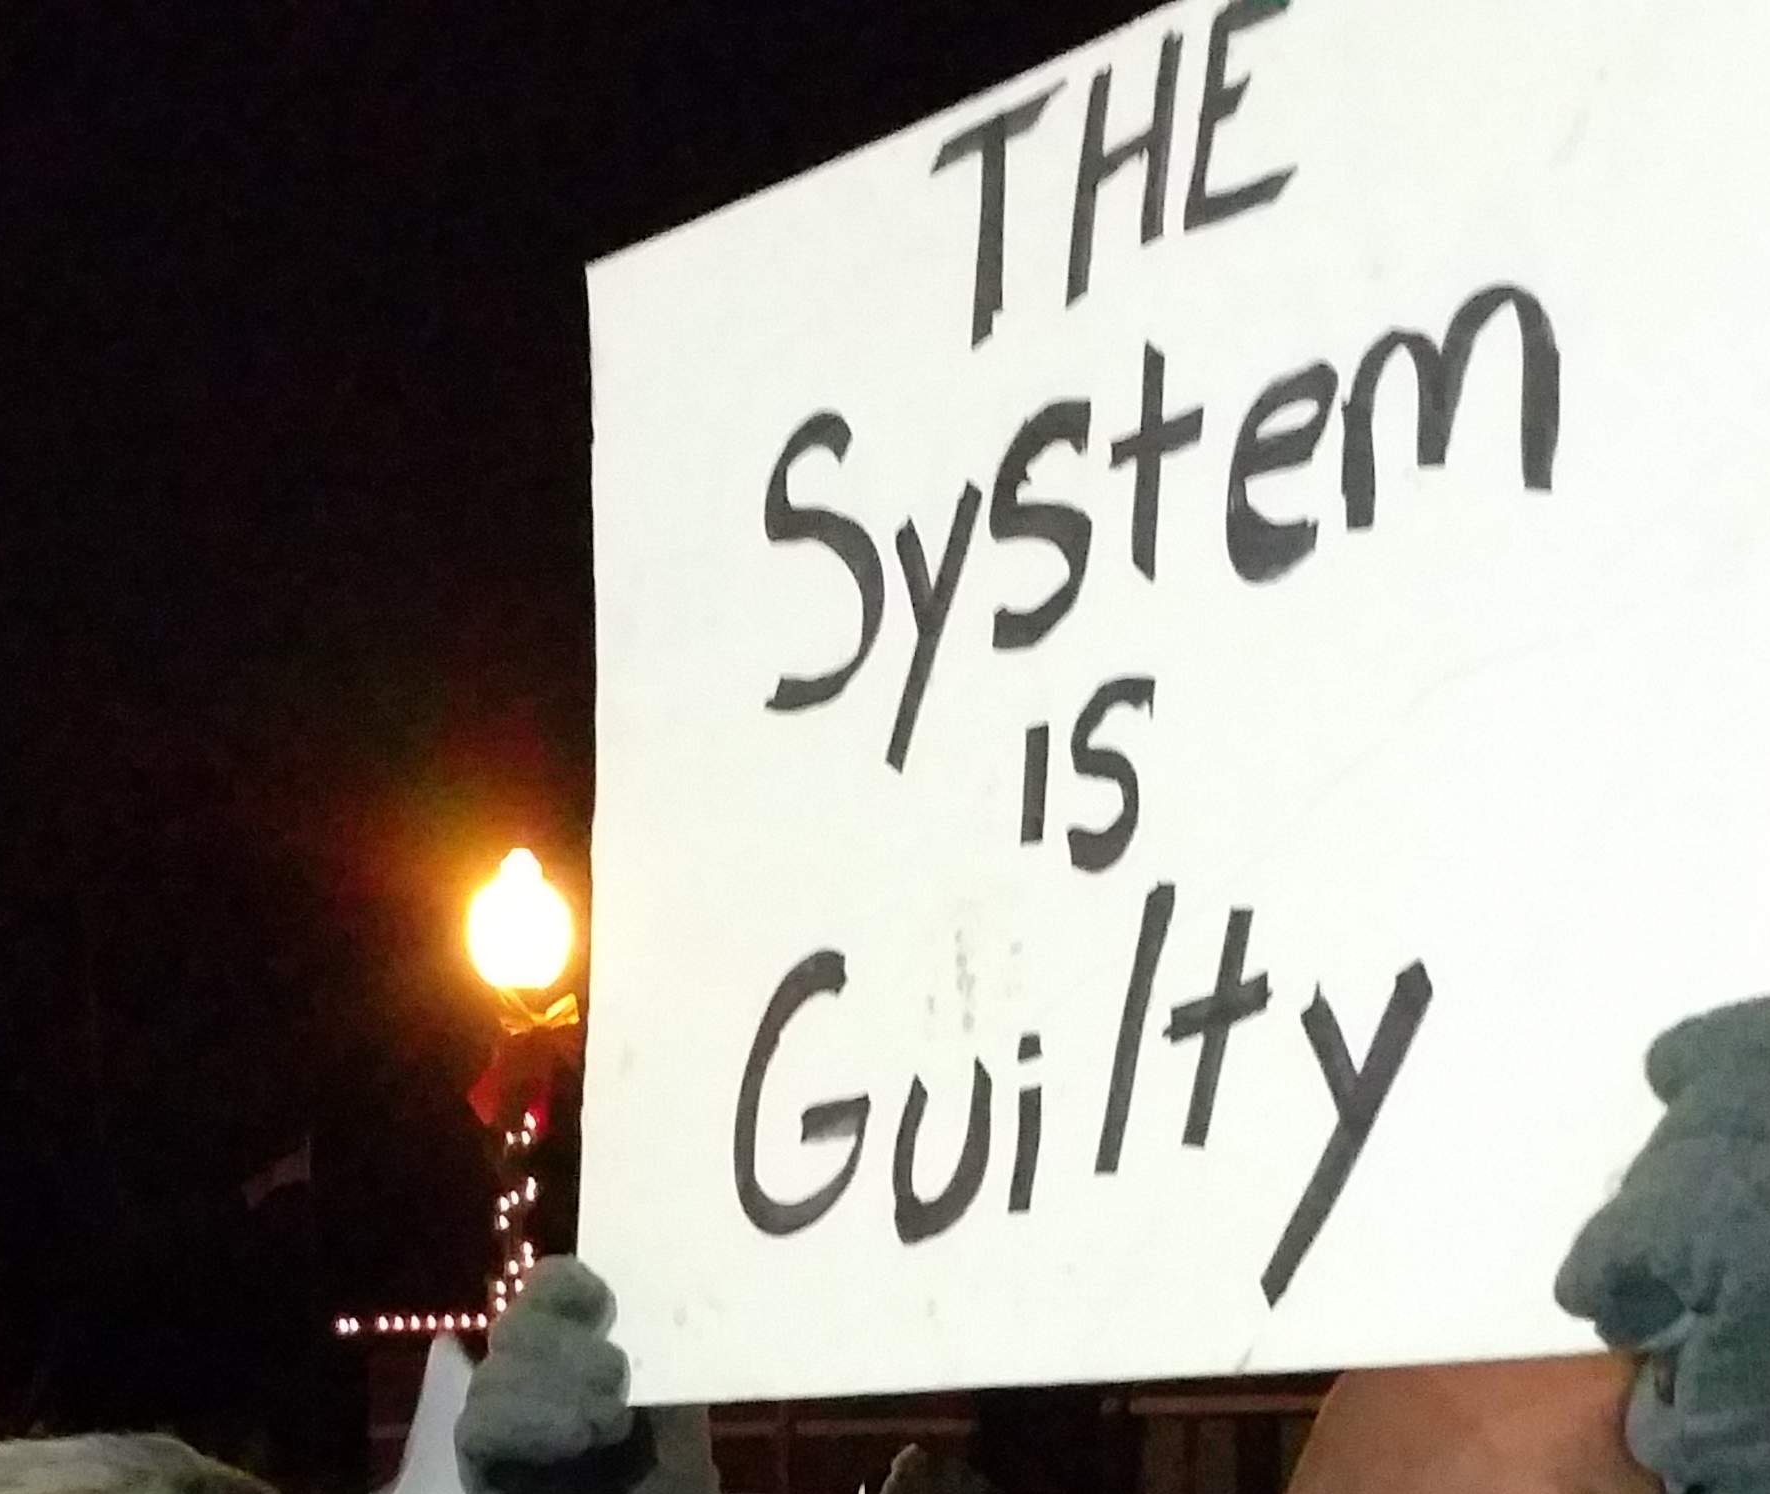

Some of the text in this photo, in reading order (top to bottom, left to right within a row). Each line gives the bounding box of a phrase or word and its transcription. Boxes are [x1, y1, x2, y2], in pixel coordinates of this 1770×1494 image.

[931, 0, 1298, 350] THE
[765, 282, 1561, 773] System
[733, 880, 1435, 1309] Guilty
